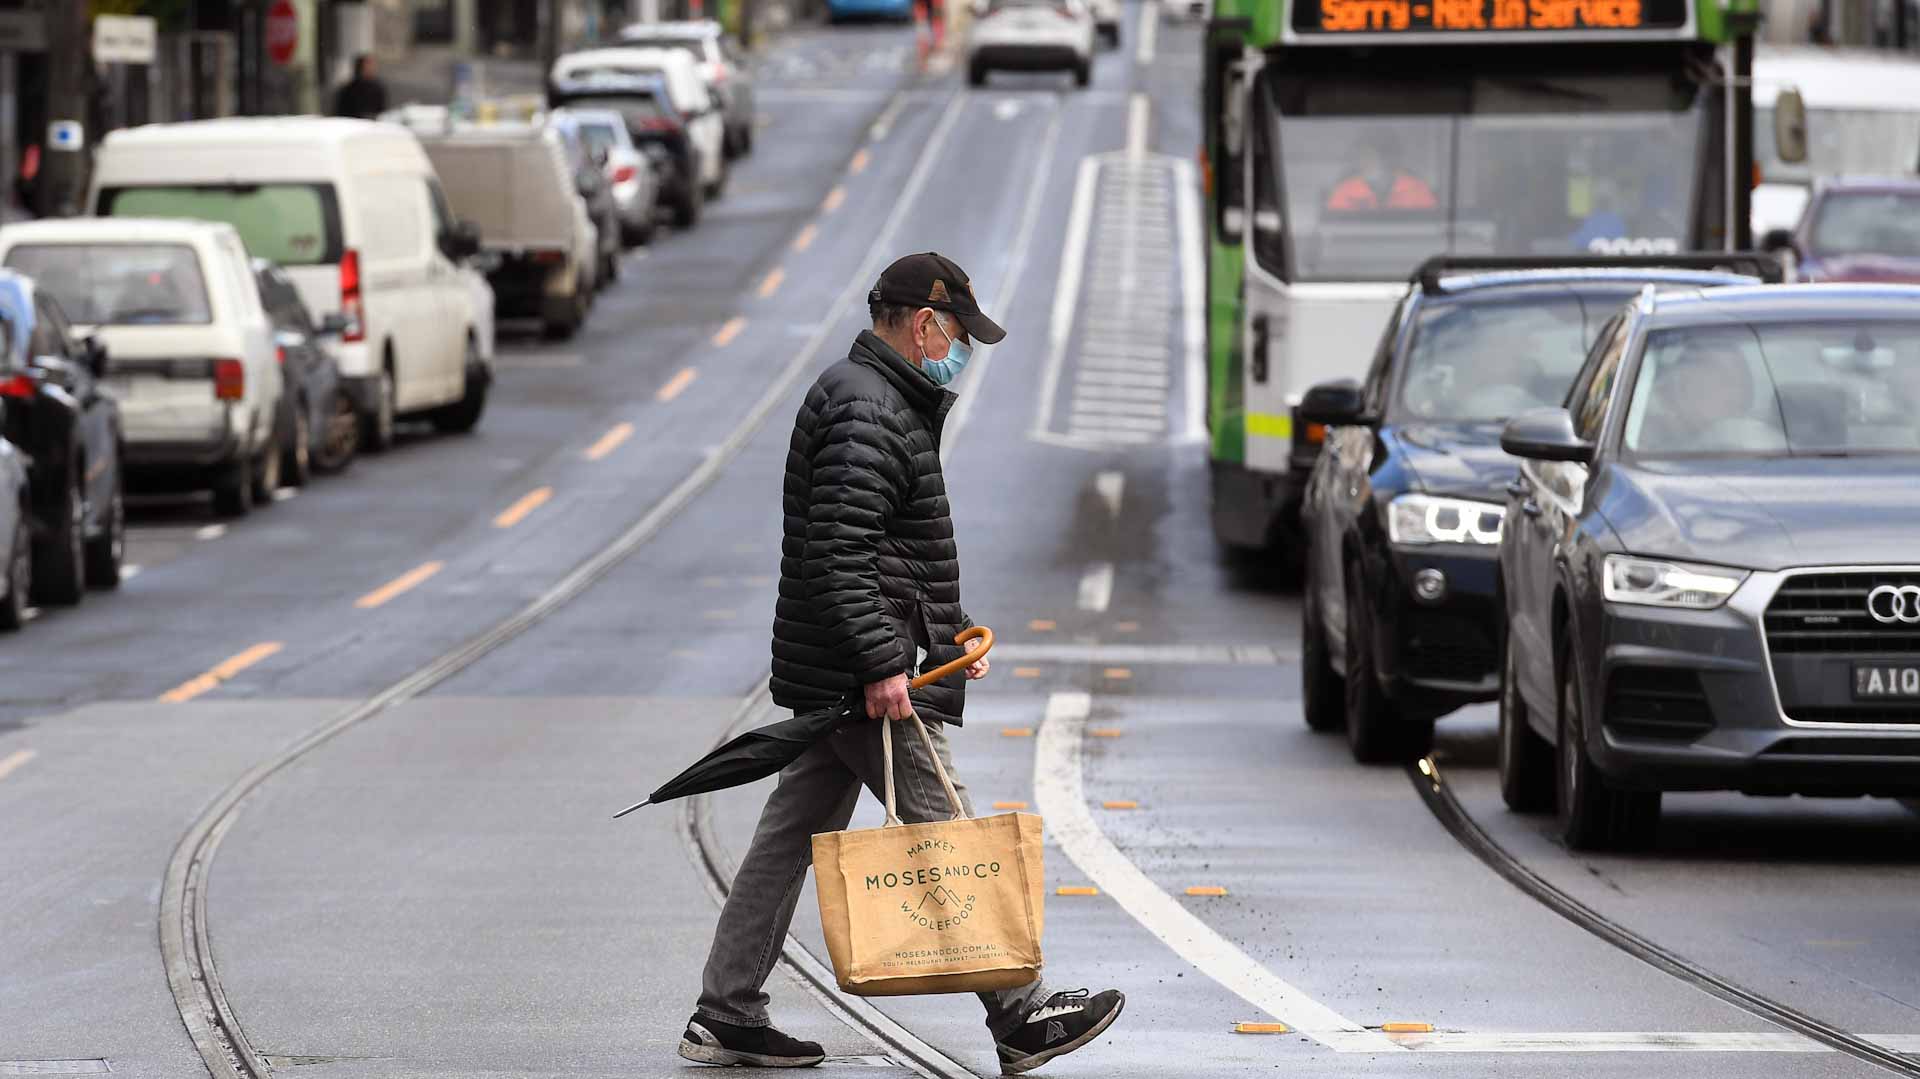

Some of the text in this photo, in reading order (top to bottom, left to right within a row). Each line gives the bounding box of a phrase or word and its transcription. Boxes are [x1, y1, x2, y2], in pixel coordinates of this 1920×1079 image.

[1321, 0, 1409, 30] Sorry
[1432, 0, 1487, 29] Not
[1491, 0, 1526, 29] In
[1530, 0, 1641, 28] Service
[907, 840, 955, 858] MARKET
[865, 867, 941, 890] MOSES
[944, 865, 970, 876] AND
[901, 894, 976, 931] WHOLEFOODS
[895, 944, 997, 959] MOSESANDCO.COM.AU
